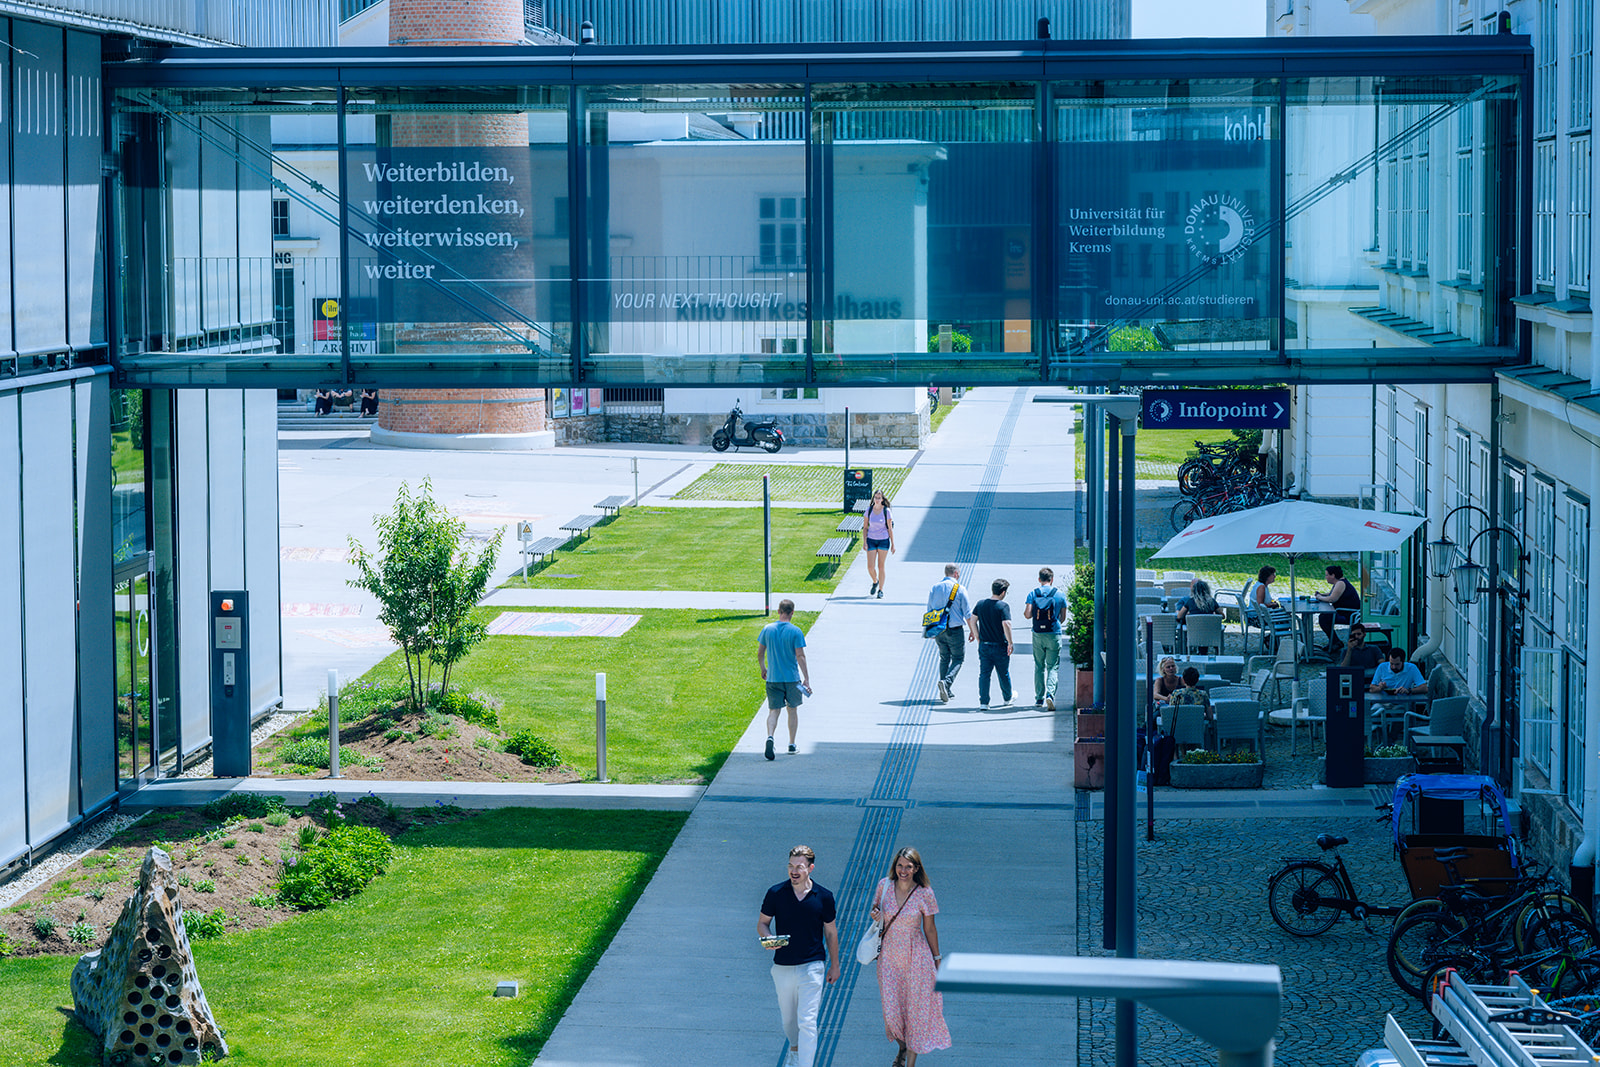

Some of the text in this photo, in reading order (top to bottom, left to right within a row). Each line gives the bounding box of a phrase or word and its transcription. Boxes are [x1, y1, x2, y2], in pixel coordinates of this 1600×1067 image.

[363, 161, 515, 186] Weiterbilden,
[363, 194, 526, 218] weiterdenken,
[1069, 208, 1166, 220] Universität für
[1184, 194, 1219, 234] DONAU
[363, 227, 519, 250] weiterwissen,
[1069, 225, 1166, 239] Weiterbildung
[1069, 242, 1112, 253] Krems
[1186, 237, 1217, 265] KREMS
[364, 260, 436, 279] weiter
[614, 292, 783, 308] YOUR NEXT THOUGHT
[1105, 295, 1254, 306] donau-uni.ac.at/studieren
[1179, 402, 1267, 422] Infopoint
[1261, 535, 1289, 546] illy
